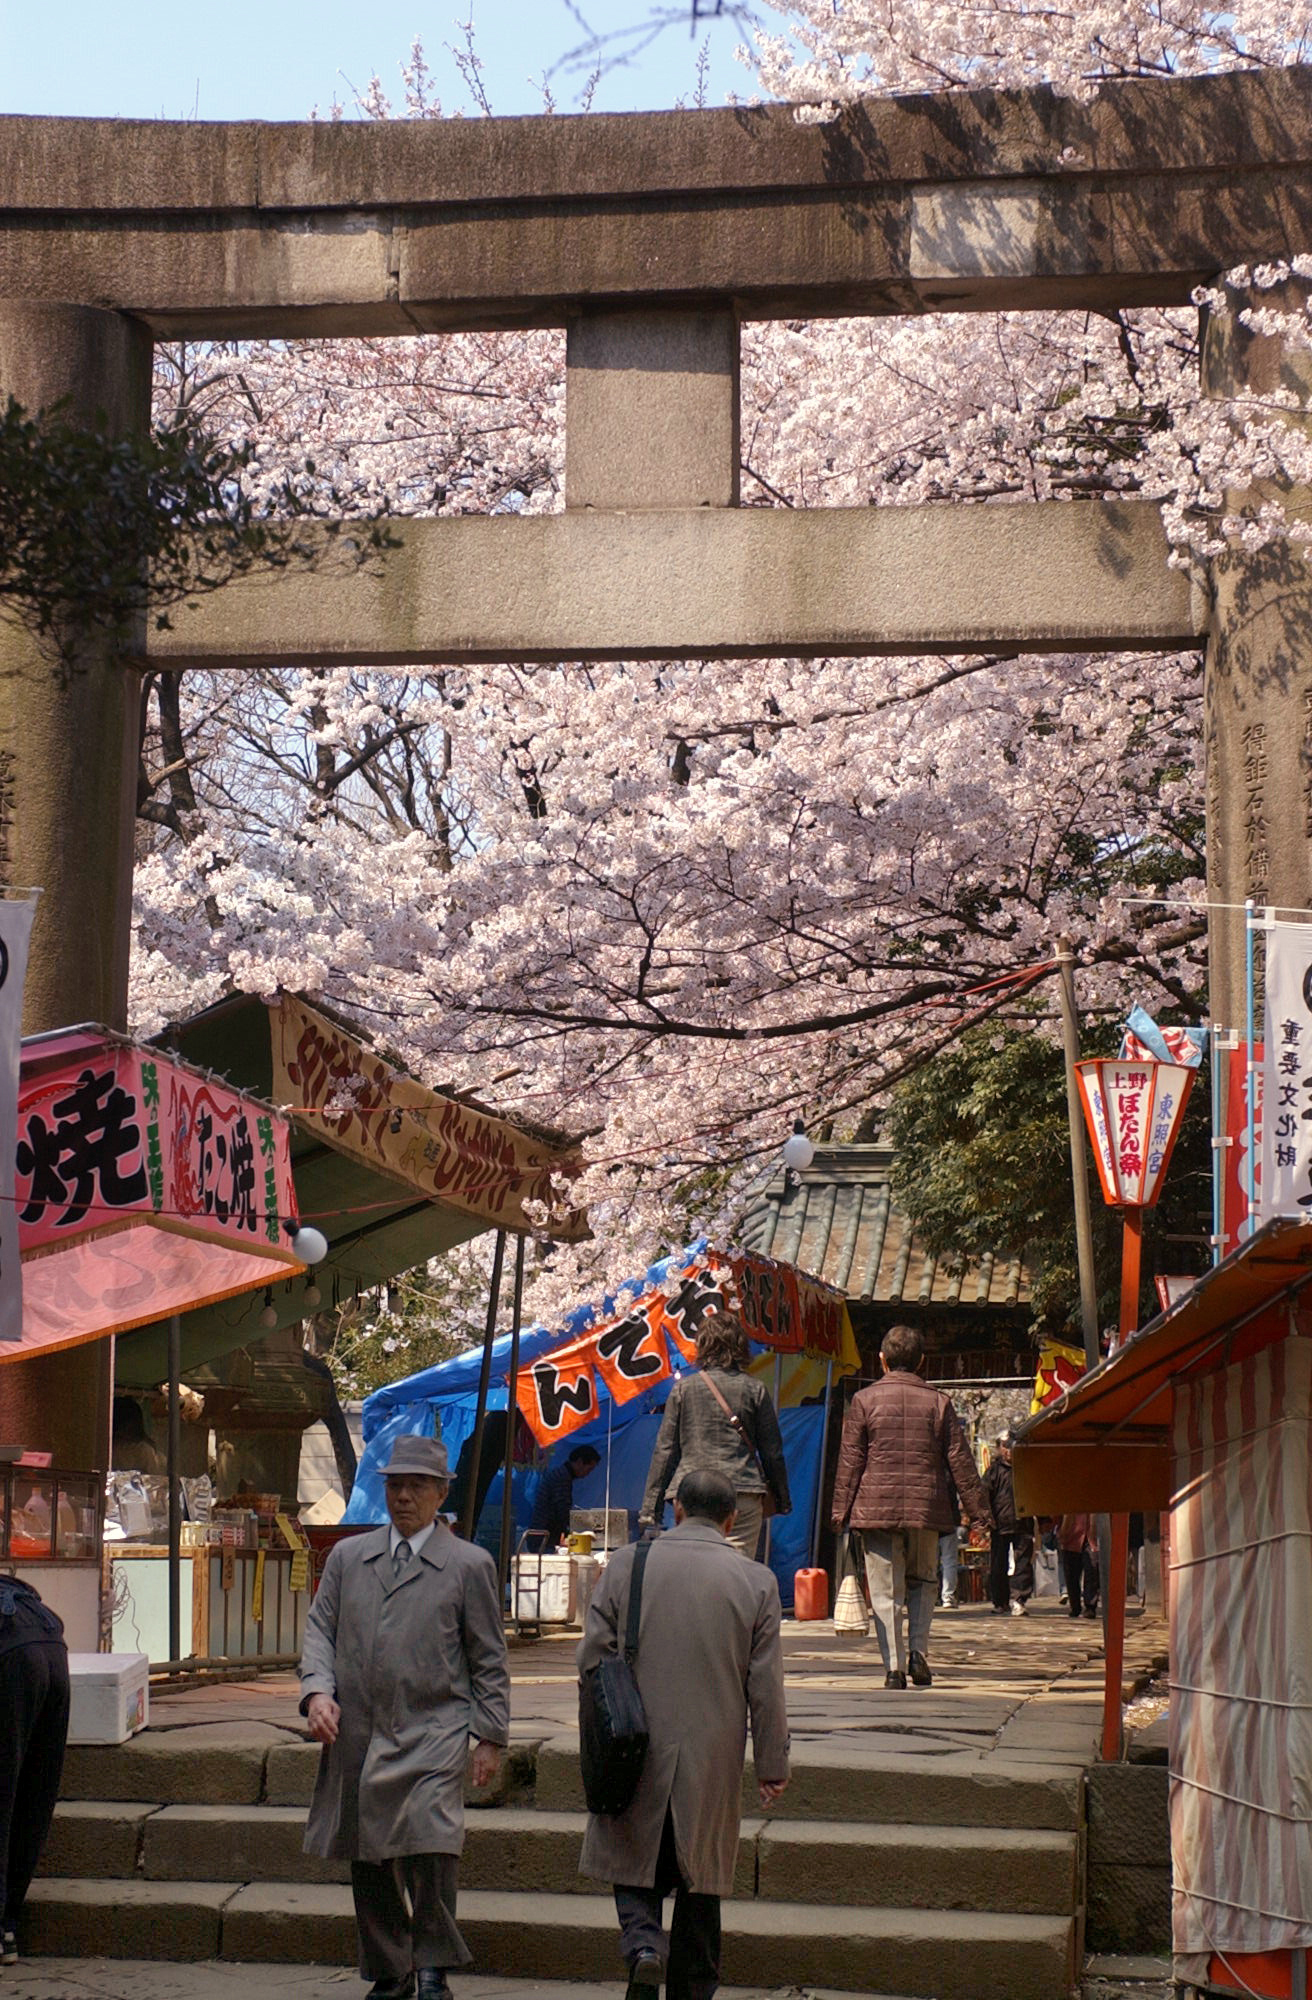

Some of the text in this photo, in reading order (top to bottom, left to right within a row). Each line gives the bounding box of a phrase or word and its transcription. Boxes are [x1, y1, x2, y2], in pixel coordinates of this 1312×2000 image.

[1108, 1071, 1148, 1090] 上野
[16, 1069, 149, 1226] 焼
[197, 1104, 258, 1232] たこ焼
[1148, 1093, 1174, 1174] 東照宮
